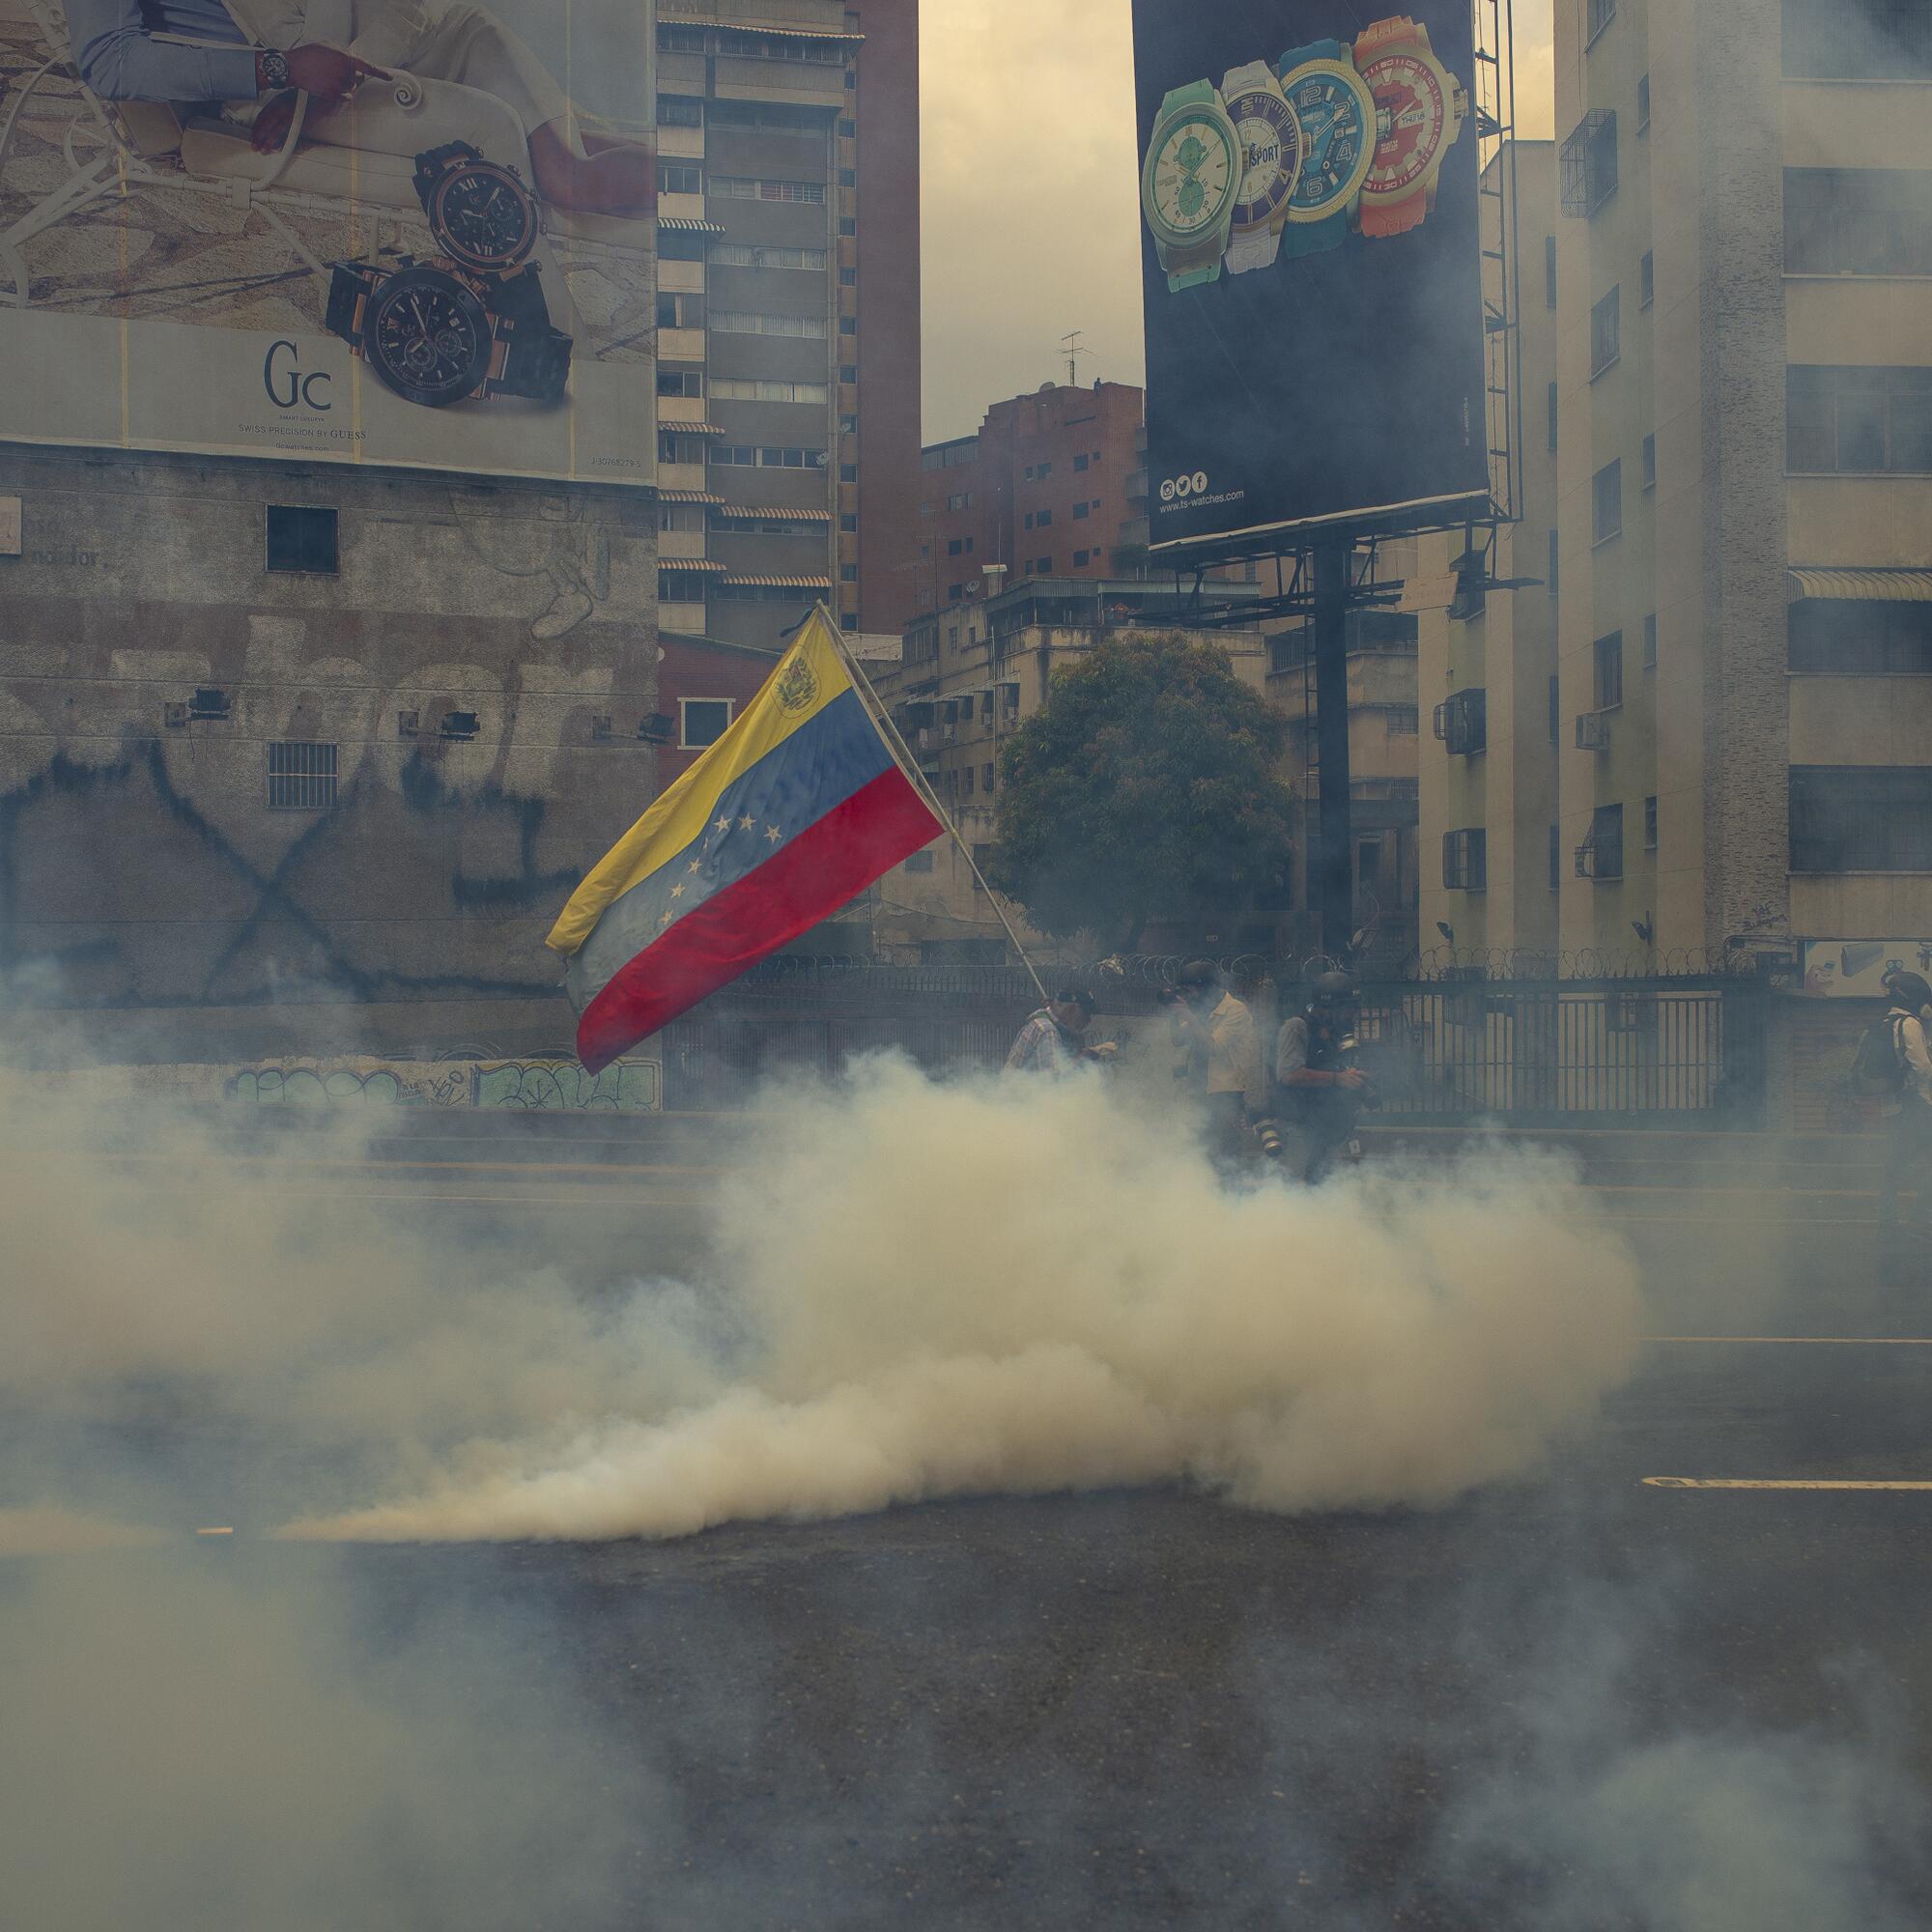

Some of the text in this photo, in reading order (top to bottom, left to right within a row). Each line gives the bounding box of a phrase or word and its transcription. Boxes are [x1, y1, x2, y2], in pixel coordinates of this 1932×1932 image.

[1300, 85, 1321, 108] 12
[1250, 144, 1280, 167] SPORT
[1335, 141, 1352, 162] 4
[1306, 176, 1323, 197] 6
[239, 424, 367, 440] SWISS PRECISION BY GUESS
[275, 441, 329, 453] Gcwatches.com
[1159, 490, 1244, 514] www.ts-watches.com
